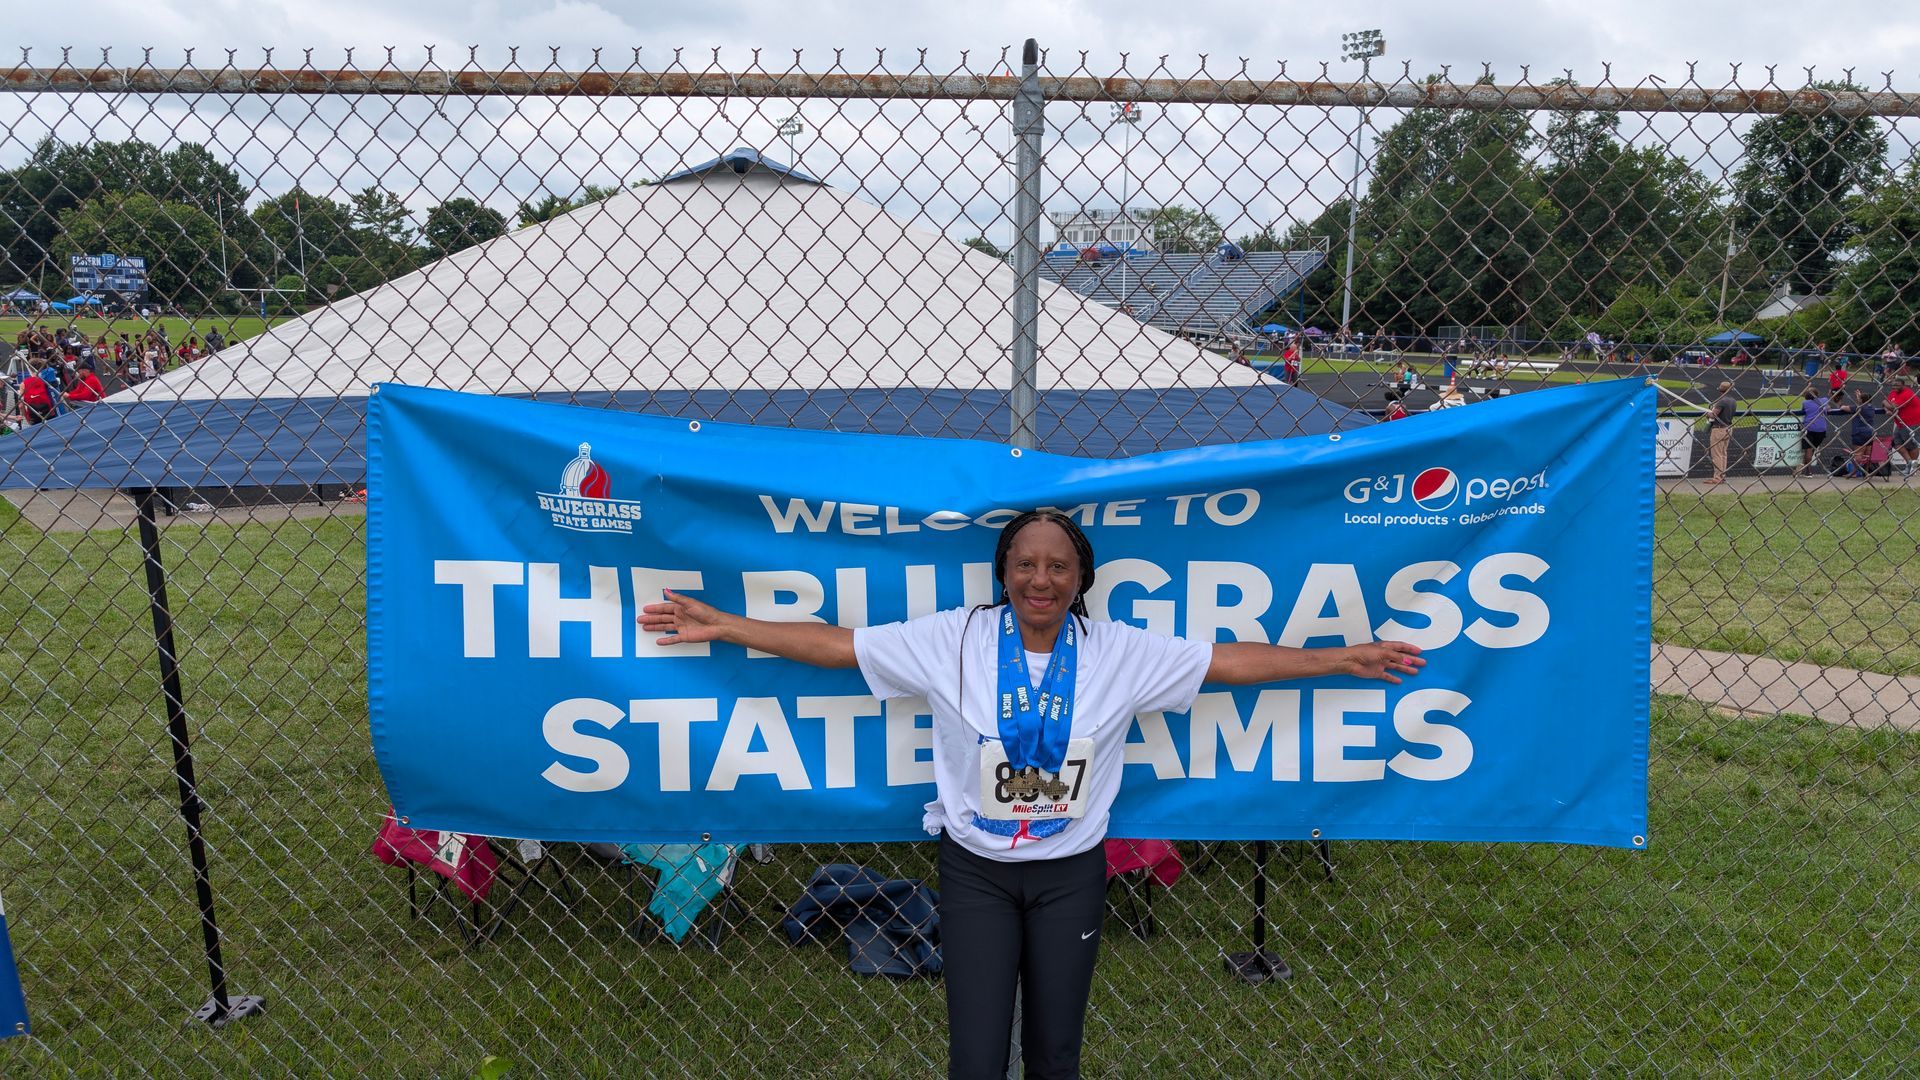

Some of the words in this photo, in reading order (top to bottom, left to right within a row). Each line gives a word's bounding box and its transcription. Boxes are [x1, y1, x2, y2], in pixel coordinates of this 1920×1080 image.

[1344, 474, 1405, 504] G&J
[1465, 465, 1548, 506] pepsi
[538, 495, 642, 520] BLUEGRASS
[1166, 488, 1261, 526] TO
[1344, 513, 1381, 525] Local
[1384, 513, 1449, 527] products
[1458, 509, 1499, 526] Global
[1499, 502, 1546, 516] brands
[551, 513, 588, 528] STATE
[591, 517, 633, 530] GAMES
[434, 560, 711, 658] THE
[742, 552, 1551, 658] BGRASS
[1004, 612, 1014, 635] DICK'S
[1066, 624, 1074, 646] DICK'S
[1003, 694, 1012, 719] DICK'S
[1017, 687, 1030, 712] DICK'S
[1051, 696, 1062, 721] DICK'S
[541, 696, 937, 793] STATE
[1123, 688, 1474, 782] AMES
[995, 759, 1087, 803] 87
[1012, 804, 1054, 814] MileSplit
